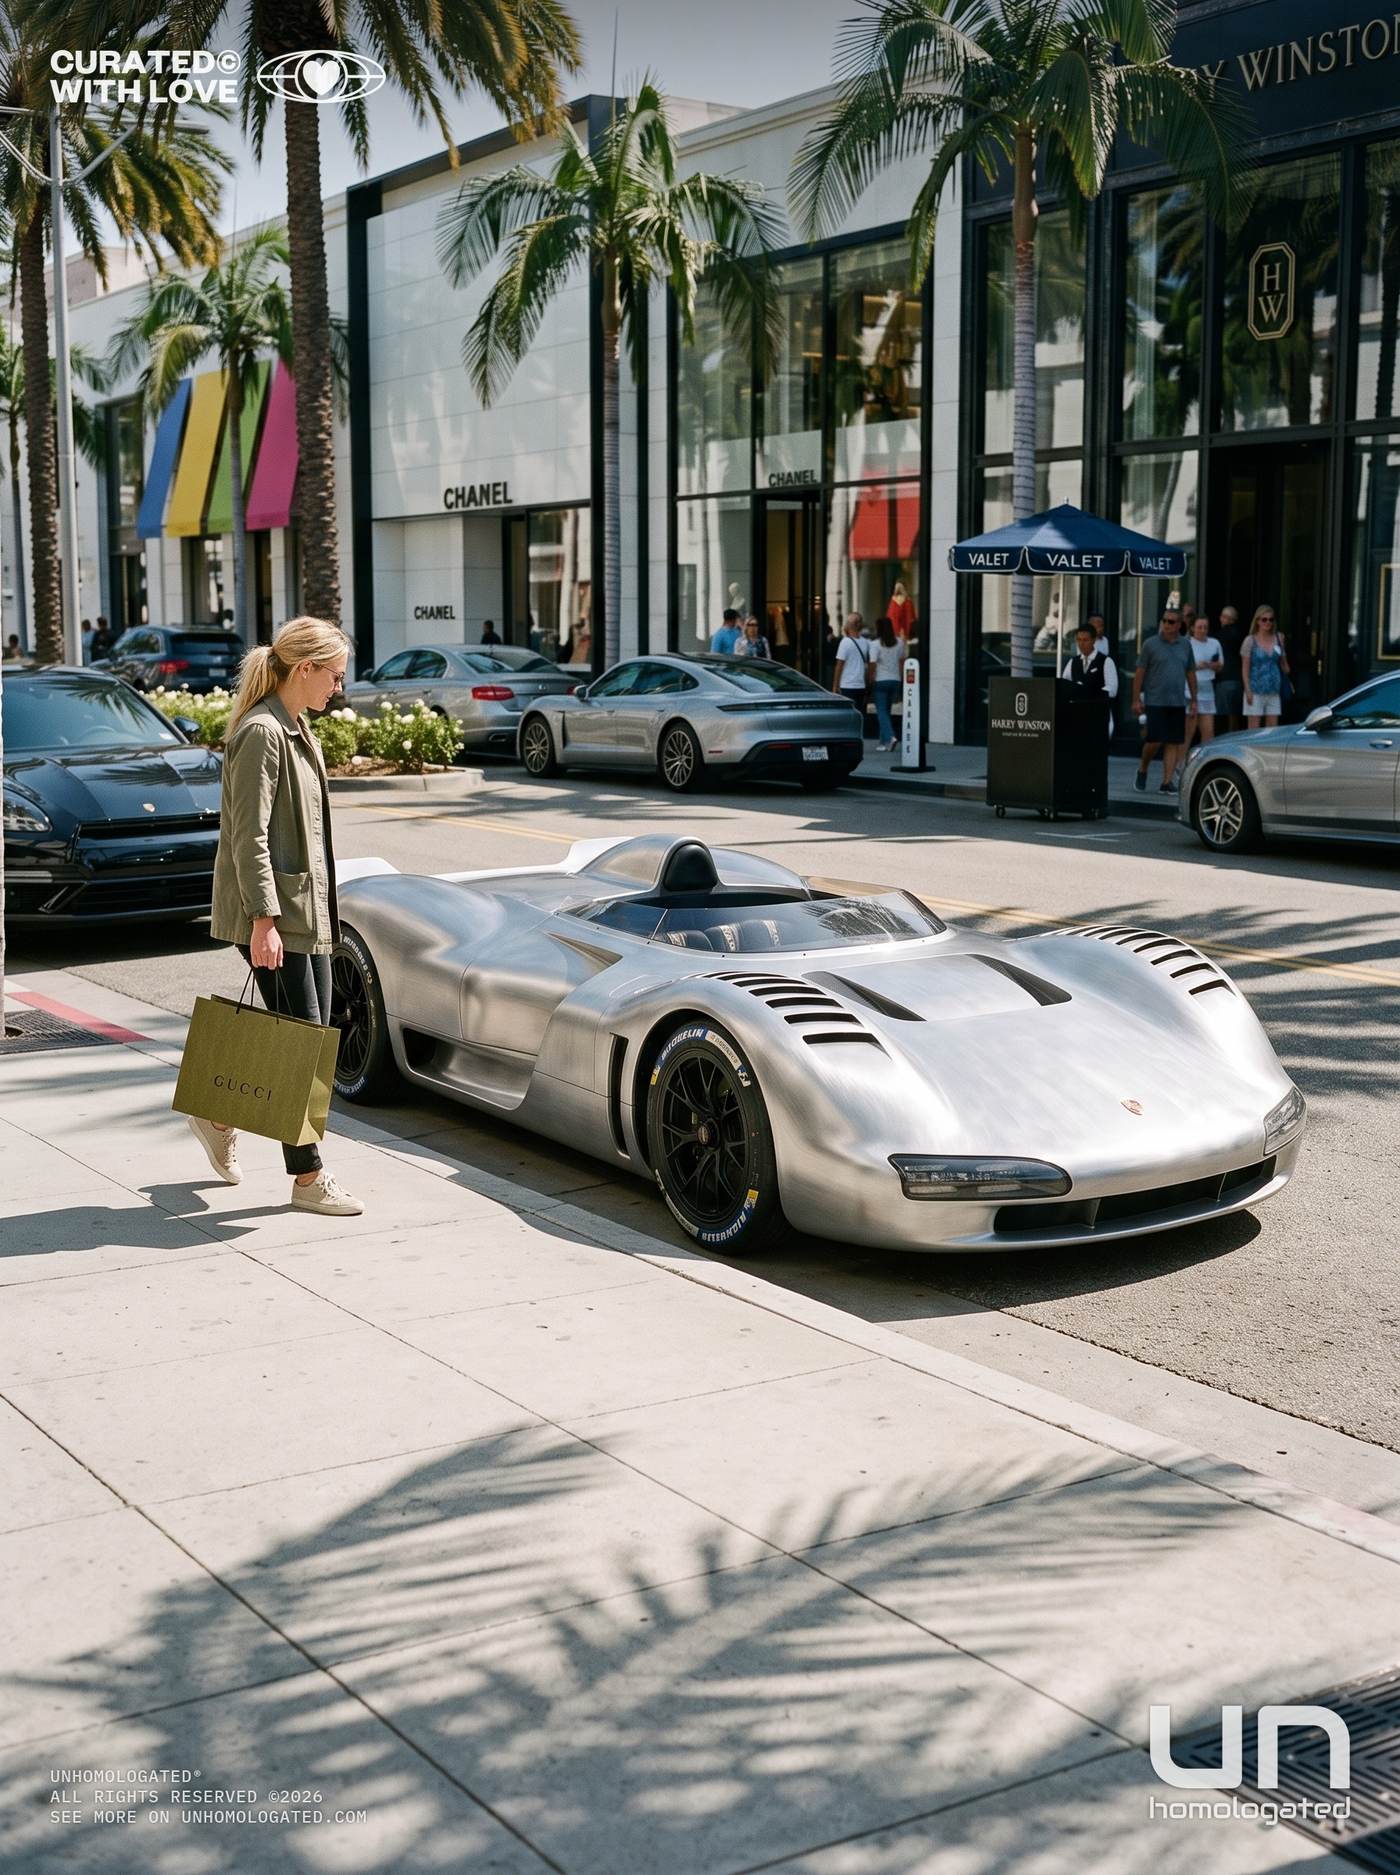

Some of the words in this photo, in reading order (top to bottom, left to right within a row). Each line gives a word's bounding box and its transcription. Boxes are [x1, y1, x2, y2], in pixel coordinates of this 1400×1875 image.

[769, 469, 816, 487] CHANEL
[443, 481, 513, 510] CHANEL
[968, 552, 1009, 567] VALET
[1046, 552, 1104, 568] VALET
[1139, 556, 1172, 571] VALET
[414, 605, 455, 620] CHANEL
[1017, 719, 1051, 731] WINSTON
[214, 1075, 272, 1101] GUCCI
